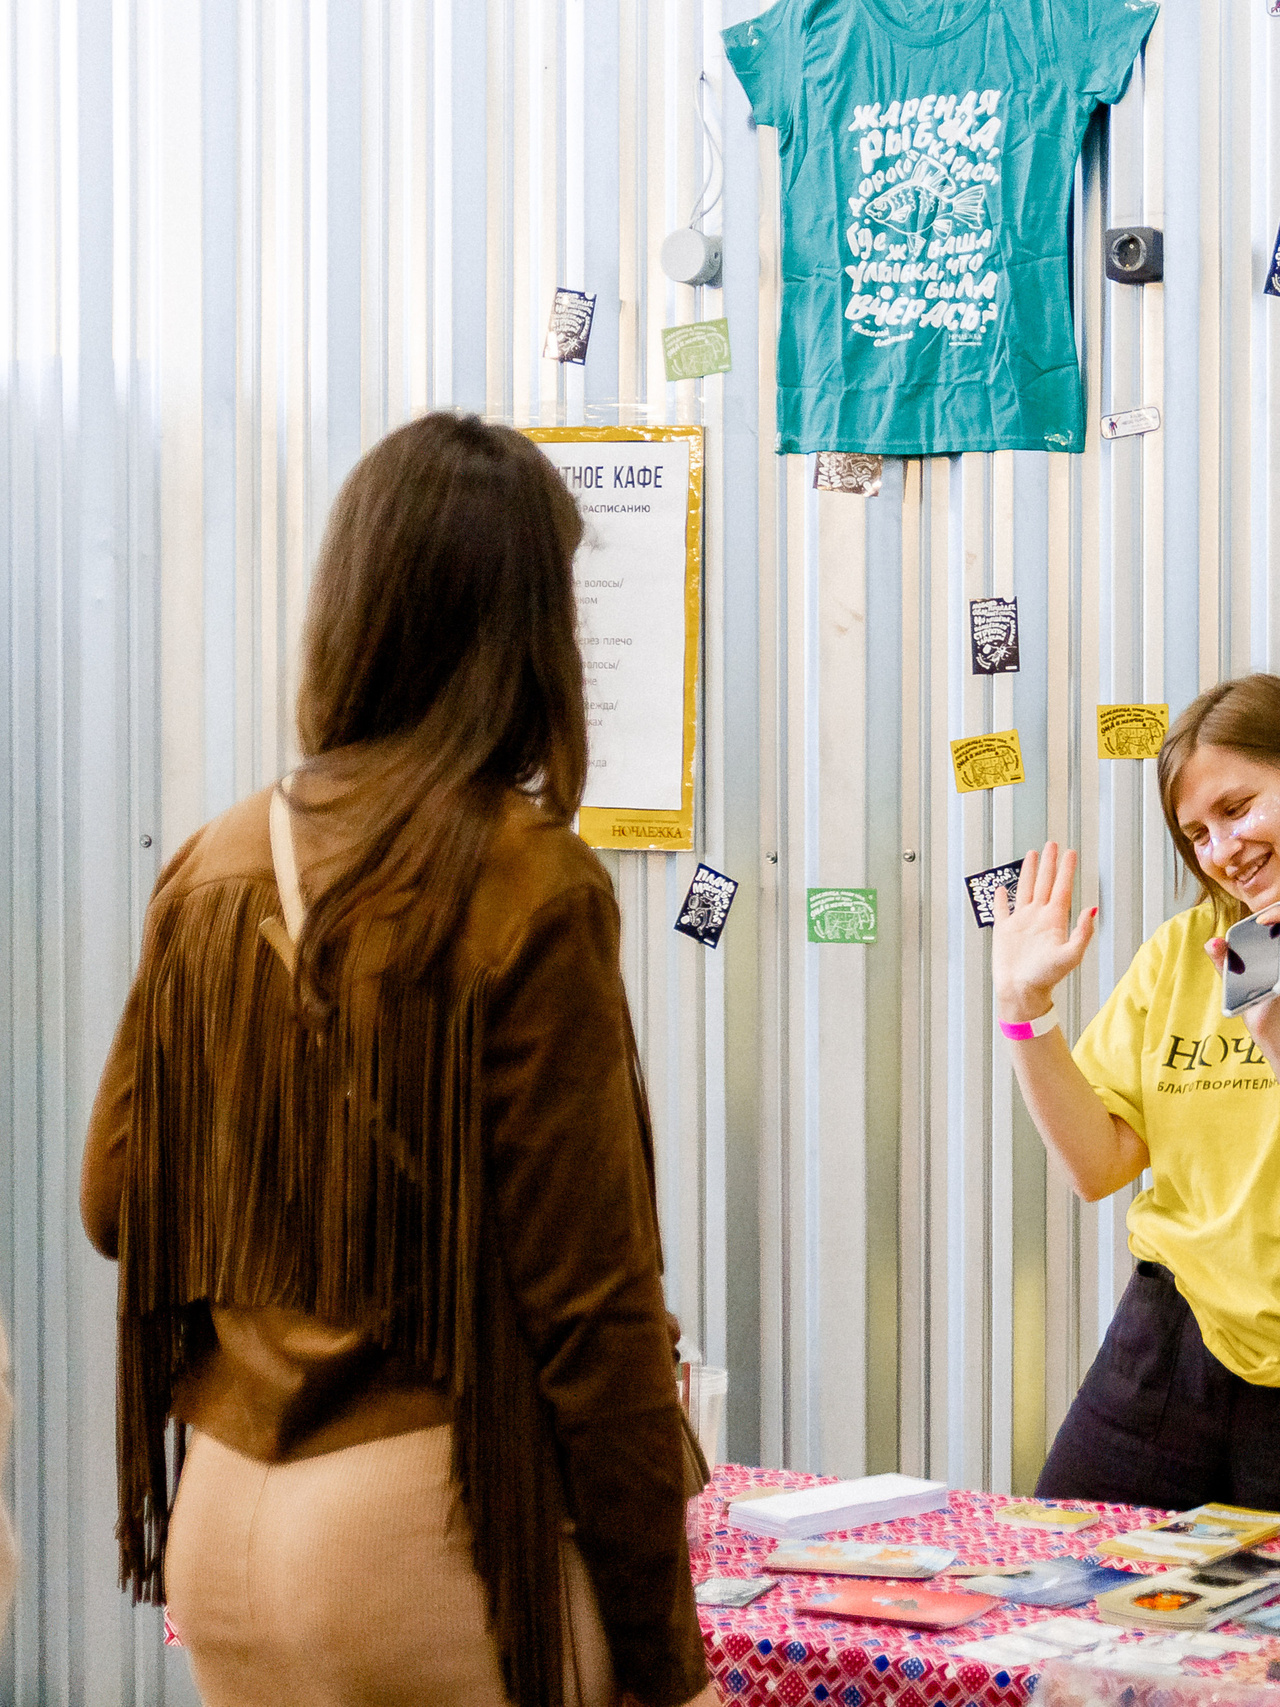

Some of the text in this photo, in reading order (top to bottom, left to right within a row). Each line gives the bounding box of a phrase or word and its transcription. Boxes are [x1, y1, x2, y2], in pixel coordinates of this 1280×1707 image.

[848, 89, 1001, 131] ЖАРЕНАЯ
[927, 229, 991, 259] ВАША
[845, 253, 983, 293] УЛЫБКА, ЧТО
[924, 271, 998, 299] БЫЛА
[844, 294, 998, 333] ВЧЕРАСЬ?
[557, 466, 664, 489] ТНОЕ КАФЕ
[582, 504, 651, 514] РАСПИСАНИЮ
[602, 637, 633, 646] плечо
[611, 825, 683, 838] НОЧЛЕЖКА
[1157, 1077, 1280, 1095] БЛАГОТВОРИТЕЛЬ
